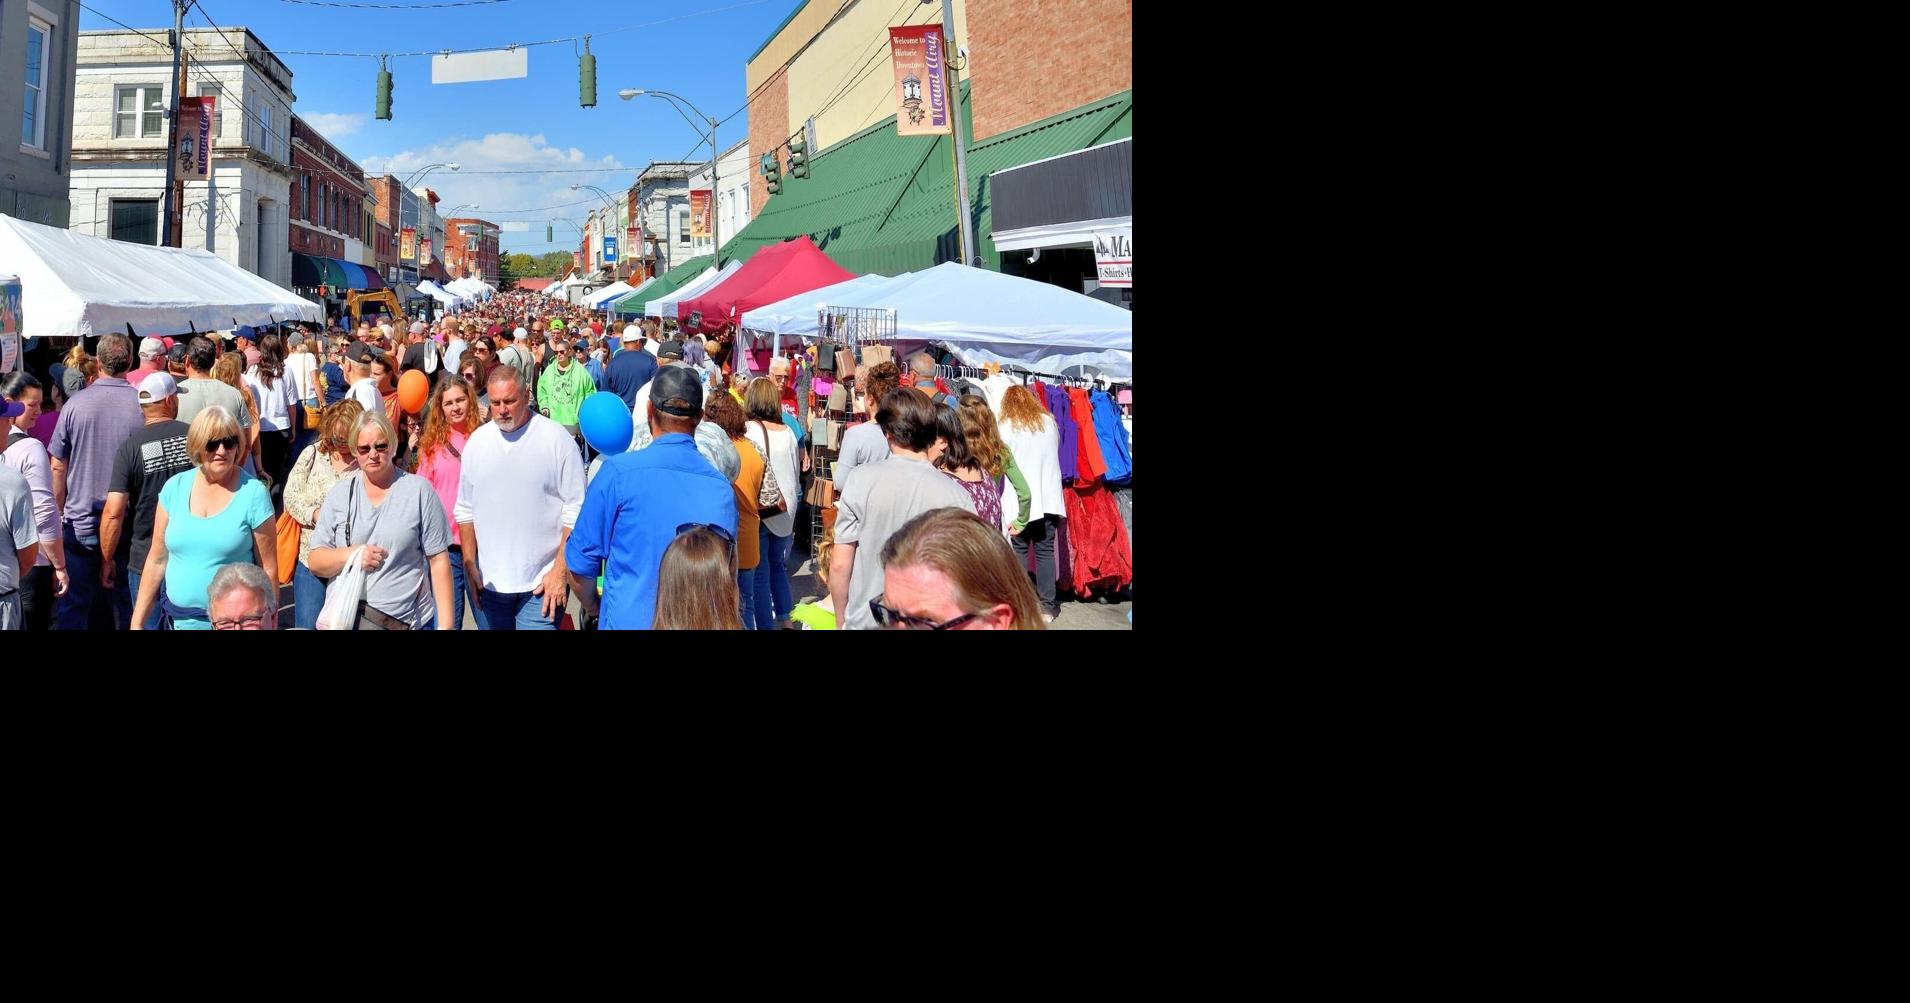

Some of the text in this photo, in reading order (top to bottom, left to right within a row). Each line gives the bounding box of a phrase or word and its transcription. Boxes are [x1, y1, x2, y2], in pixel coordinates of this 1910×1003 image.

[895, 48, 917, 57] Historic
[925, 34, 944, 125] Mount Airy
